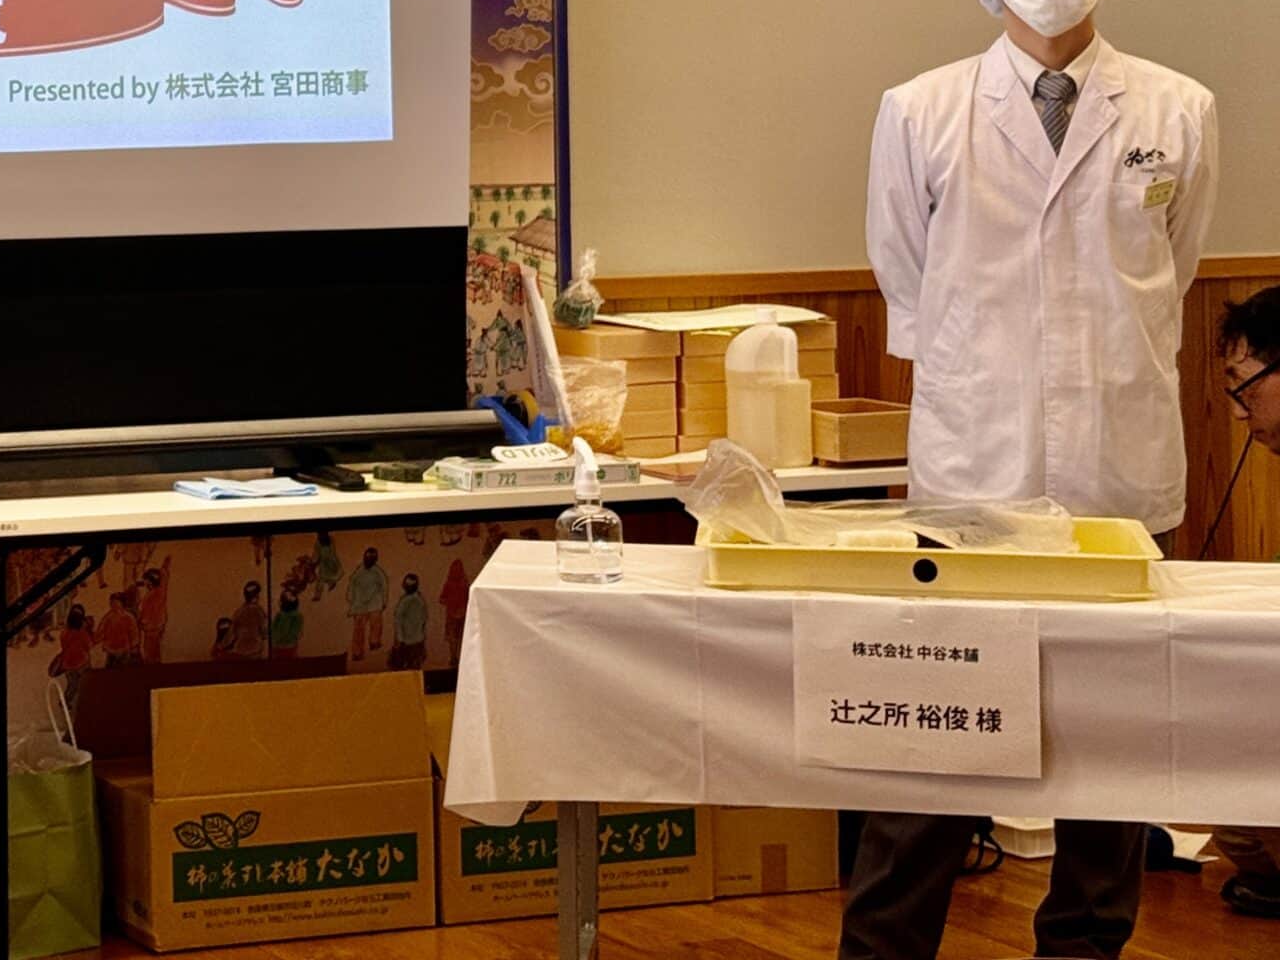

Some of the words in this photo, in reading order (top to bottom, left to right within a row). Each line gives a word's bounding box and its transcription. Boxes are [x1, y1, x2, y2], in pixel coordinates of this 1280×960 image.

[8, 74, 124, 102] Presented
[131, 74, 160, 104] by
[165, 72, 265, 100] 株式会社
[270, 69, 370, 98] 宮田商事
[497, 472, 518, 487] 722
[852, 641, 914, 660] 株式会社
[917, 644, 980, 663] 中谷本舗
[830, 698, 910, 729] 辻之所
[916, 703, 969, 732] 裕俊
[975, 706, 1003, 734] 様
